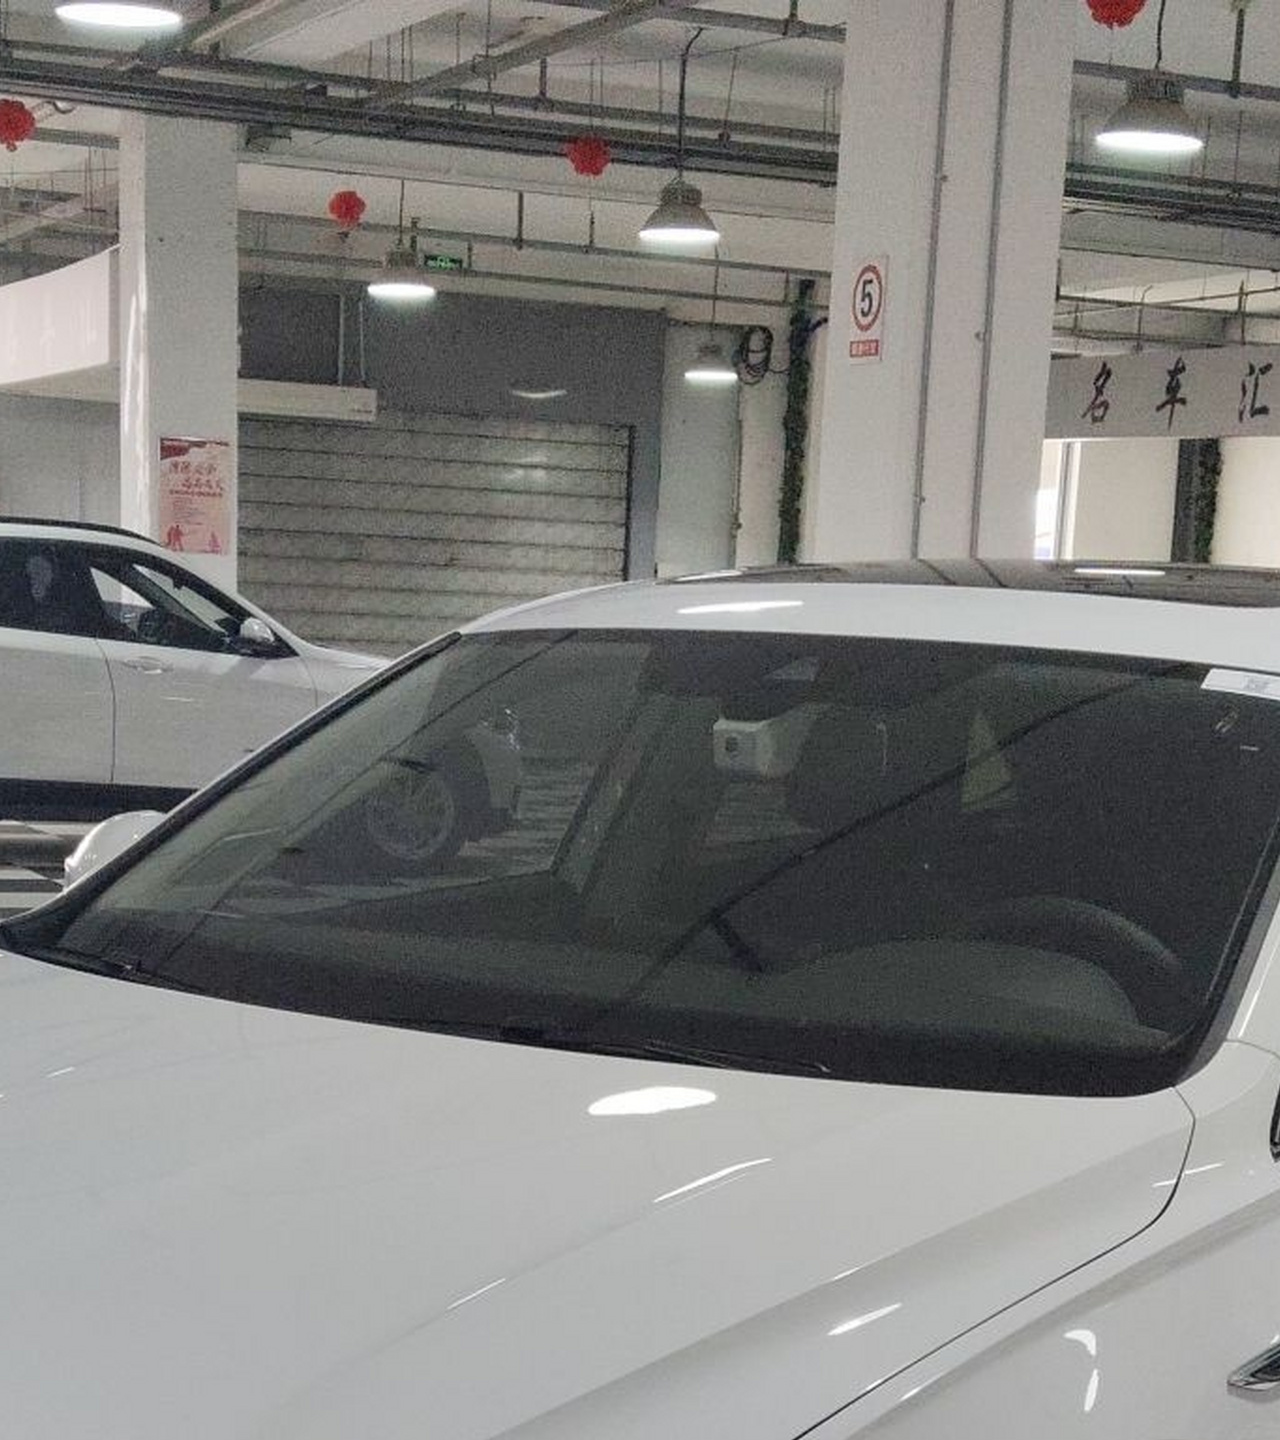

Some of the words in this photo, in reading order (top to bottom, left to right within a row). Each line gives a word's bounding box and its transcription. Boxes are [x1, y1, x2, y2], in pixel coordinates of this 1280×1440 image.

[861, 279, 873, 318] 5
[1082, 356, 1272, 426] 名车汇
